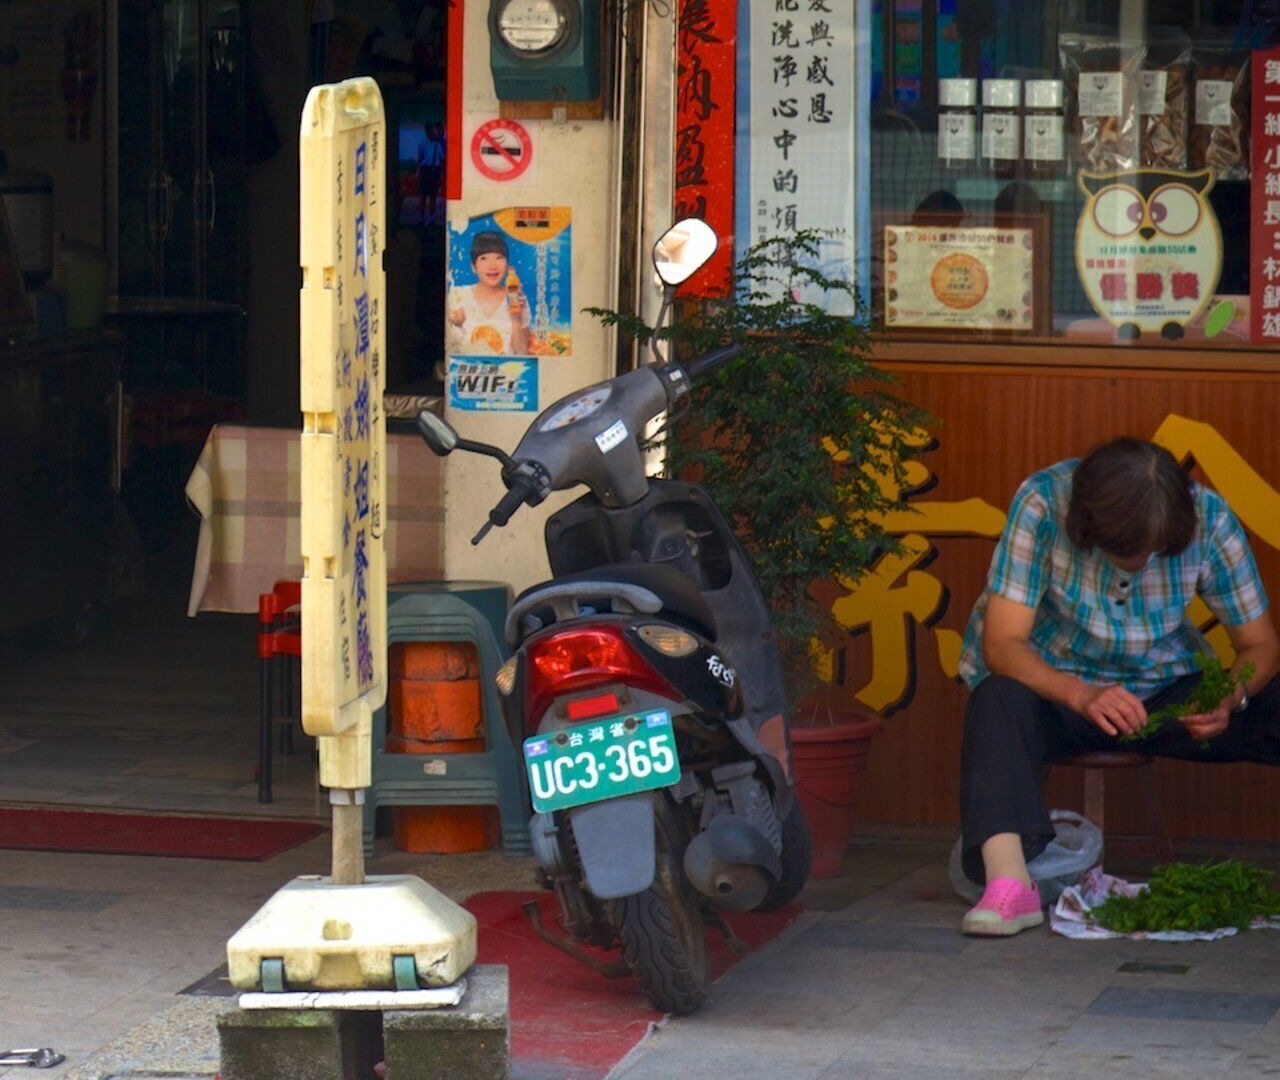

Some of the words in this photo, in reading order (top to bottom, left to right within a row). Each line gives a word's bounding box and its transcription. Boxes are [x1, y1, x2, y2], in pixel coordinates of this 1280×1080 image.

[569, 722, 625, 747] 台灣省
[530, 734, 675, 800] UC3-365
